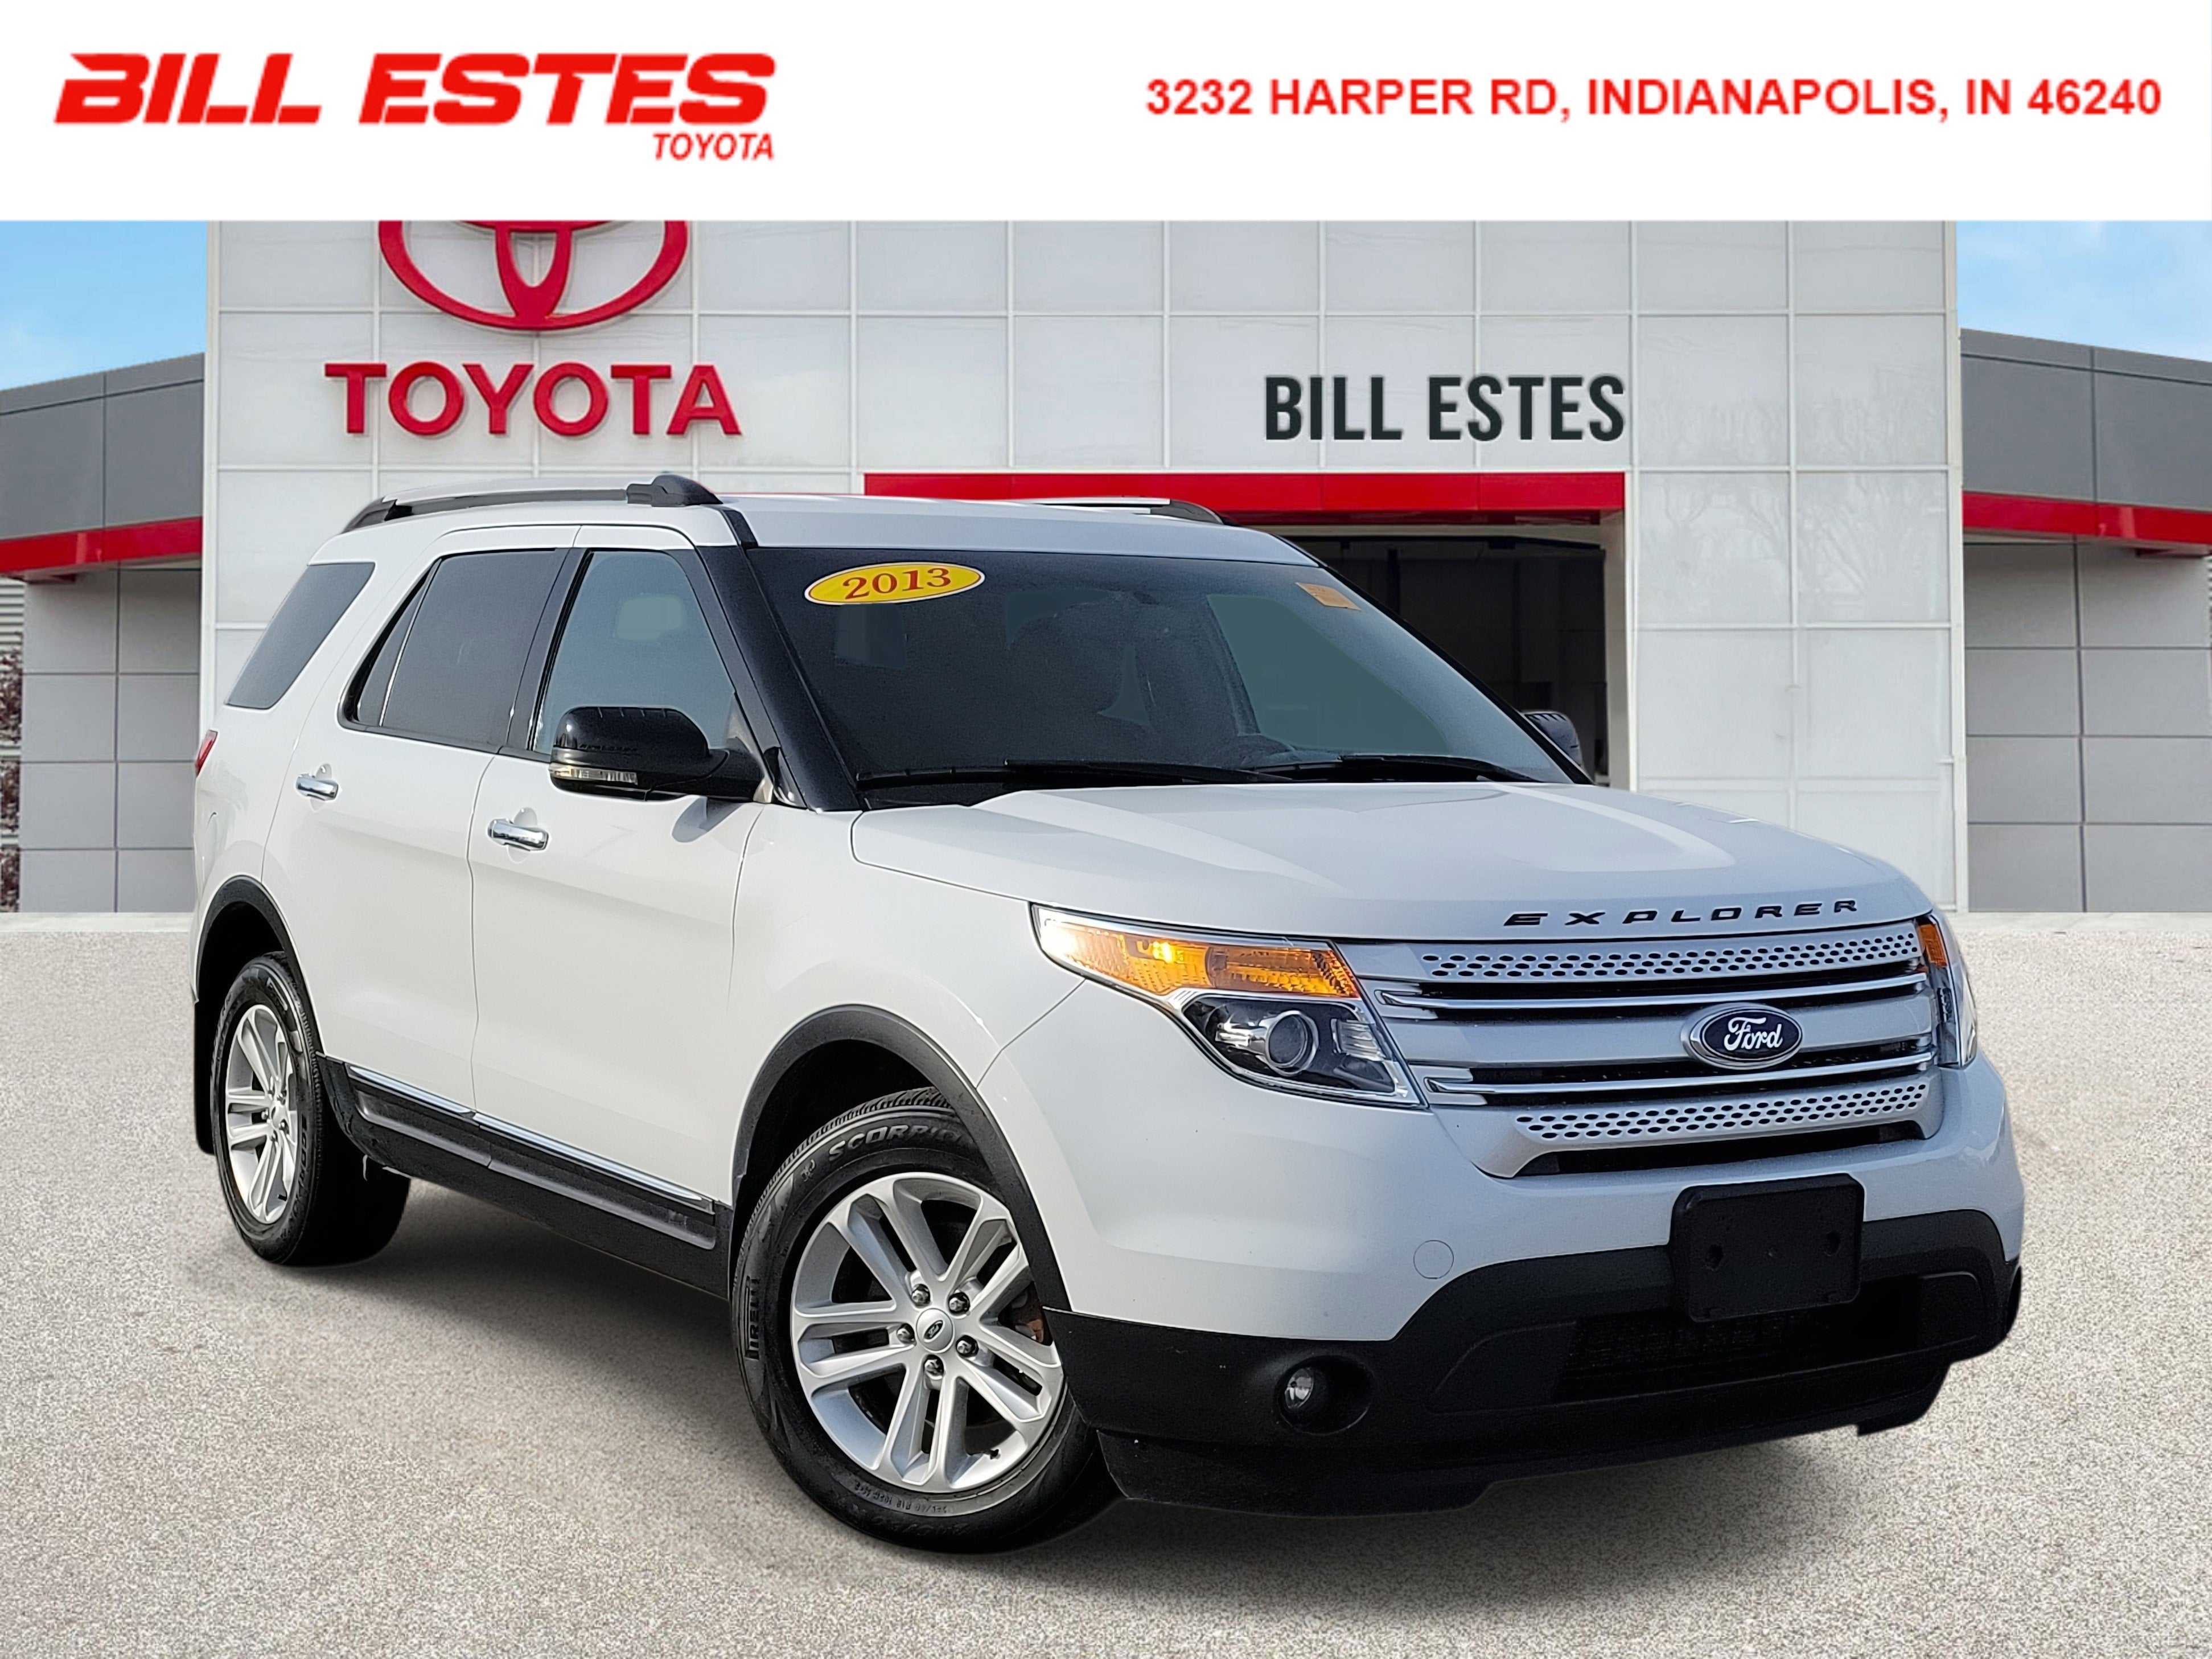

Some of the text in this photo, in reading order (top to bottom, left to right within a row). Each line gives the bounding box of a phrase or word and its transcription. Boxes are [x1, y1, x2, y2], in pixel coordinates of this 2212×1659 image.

[324, 362, 742, 437] TOYOTA
[1265, 374, 1626, 442] BILL ESTES
[842, 568, 951, 600] 2013
[1503, 900, 1858, 927] EXPLORER
[1724, 1017, 1783, 1051] Ford
